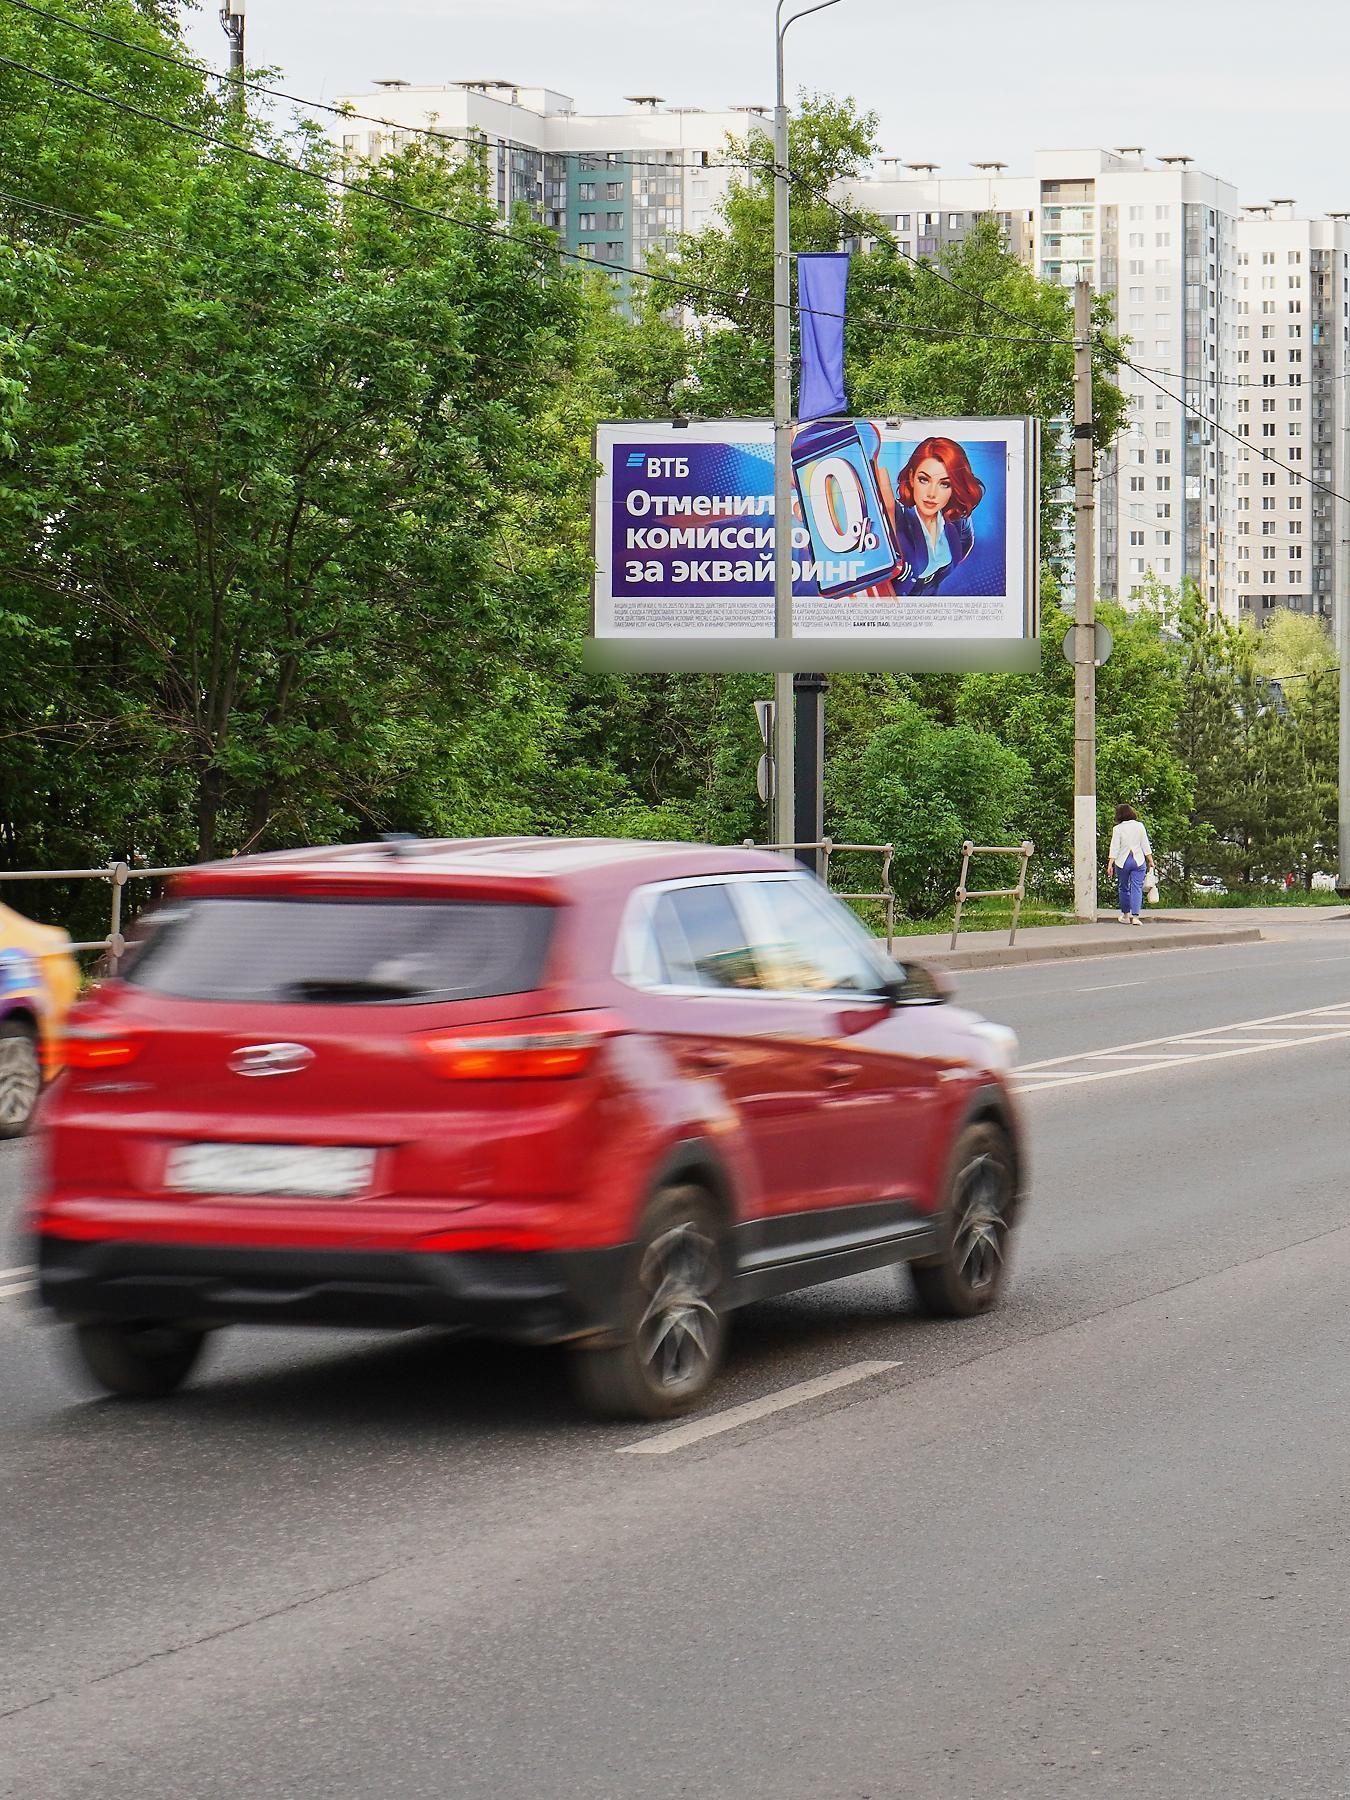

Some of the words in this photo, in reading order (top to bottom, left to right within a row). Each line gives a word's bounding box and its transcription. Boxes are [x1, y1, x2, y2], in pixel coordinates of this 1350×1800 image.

[647, 457, 690, 478] ВТБ
[626, 489, 799, 516] Отменил
[808, 456, 878, 554] 0%
[625, 560, 664, 583] за
